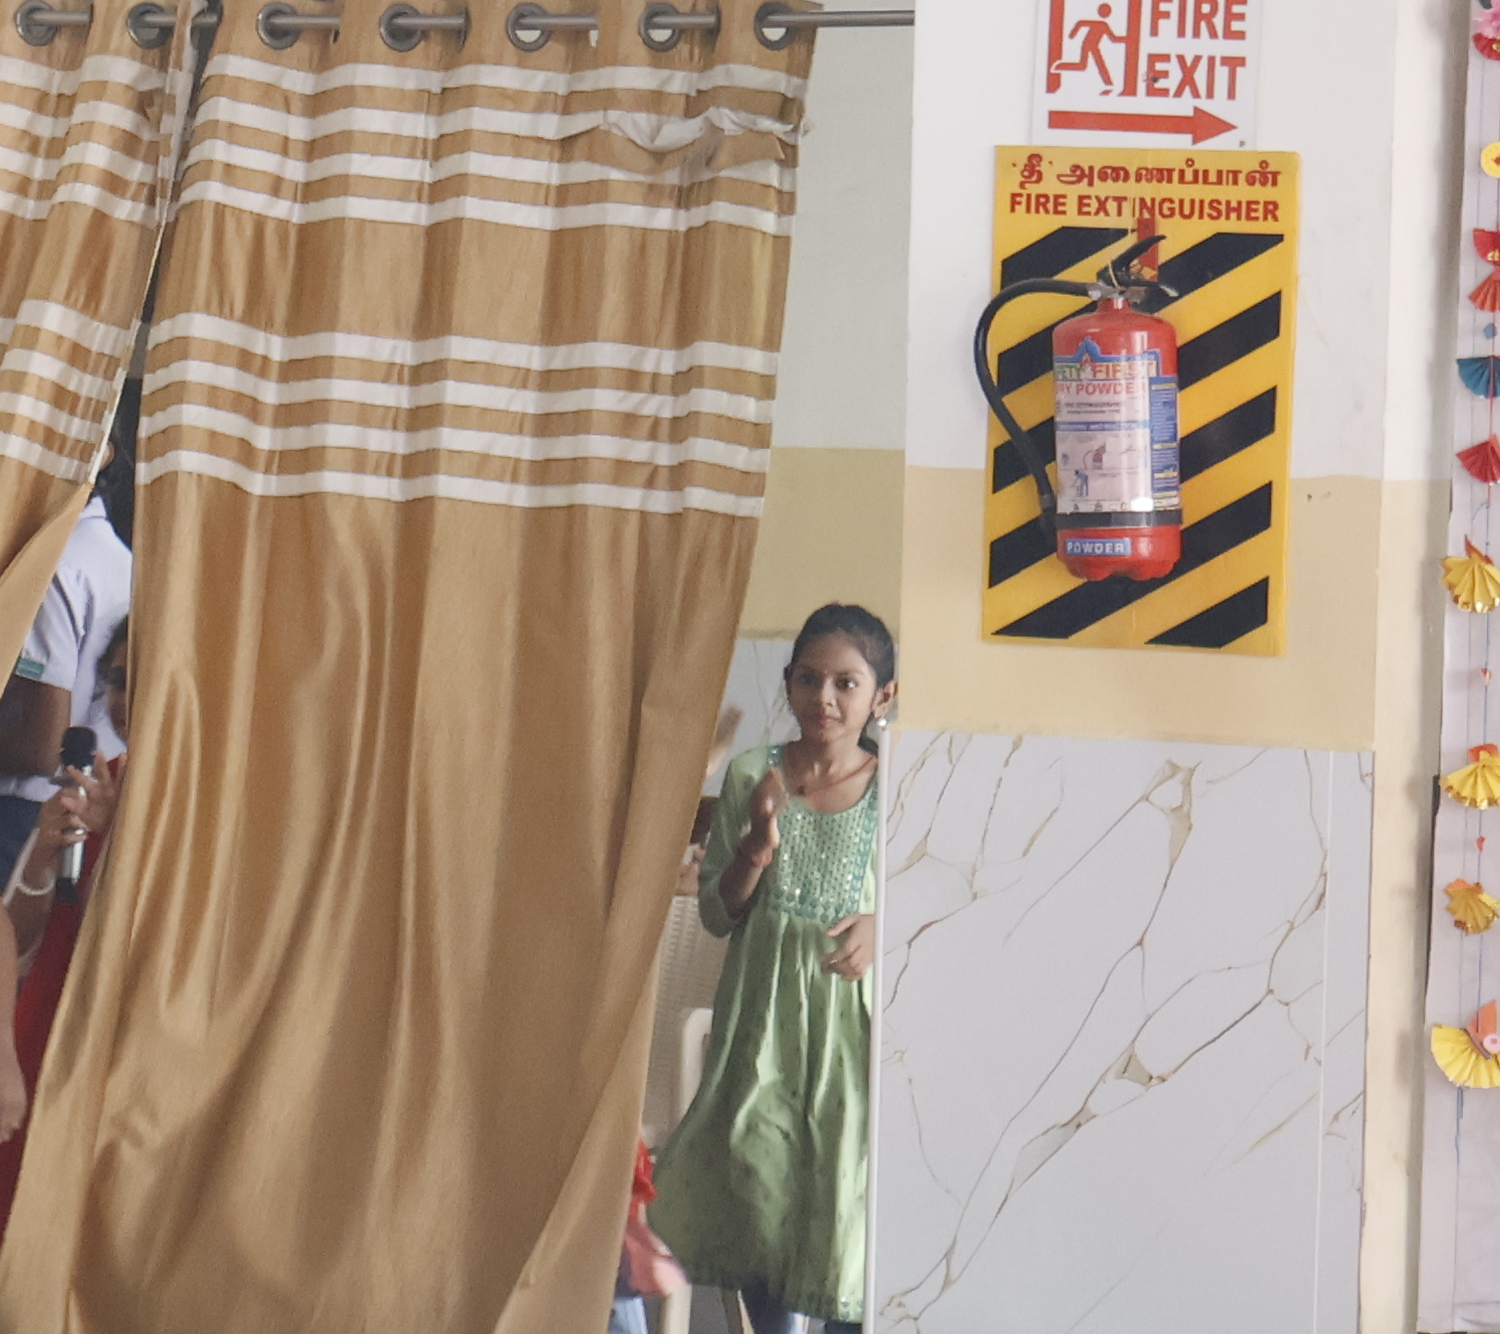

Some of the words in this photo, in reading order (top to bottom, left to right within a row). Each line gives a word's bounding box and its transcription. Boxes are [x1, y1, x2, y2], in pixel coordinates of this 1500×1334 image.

[1145, 53, 1247, 101] EXIT
[1056, 157, 1282, 187] அணைப்பான்
[1010, 193, 1067, 215] FIRE
[1077, 194, 1280, 222] EXTINGUISHER
[1066, 540, 1126, 554] POWDER
